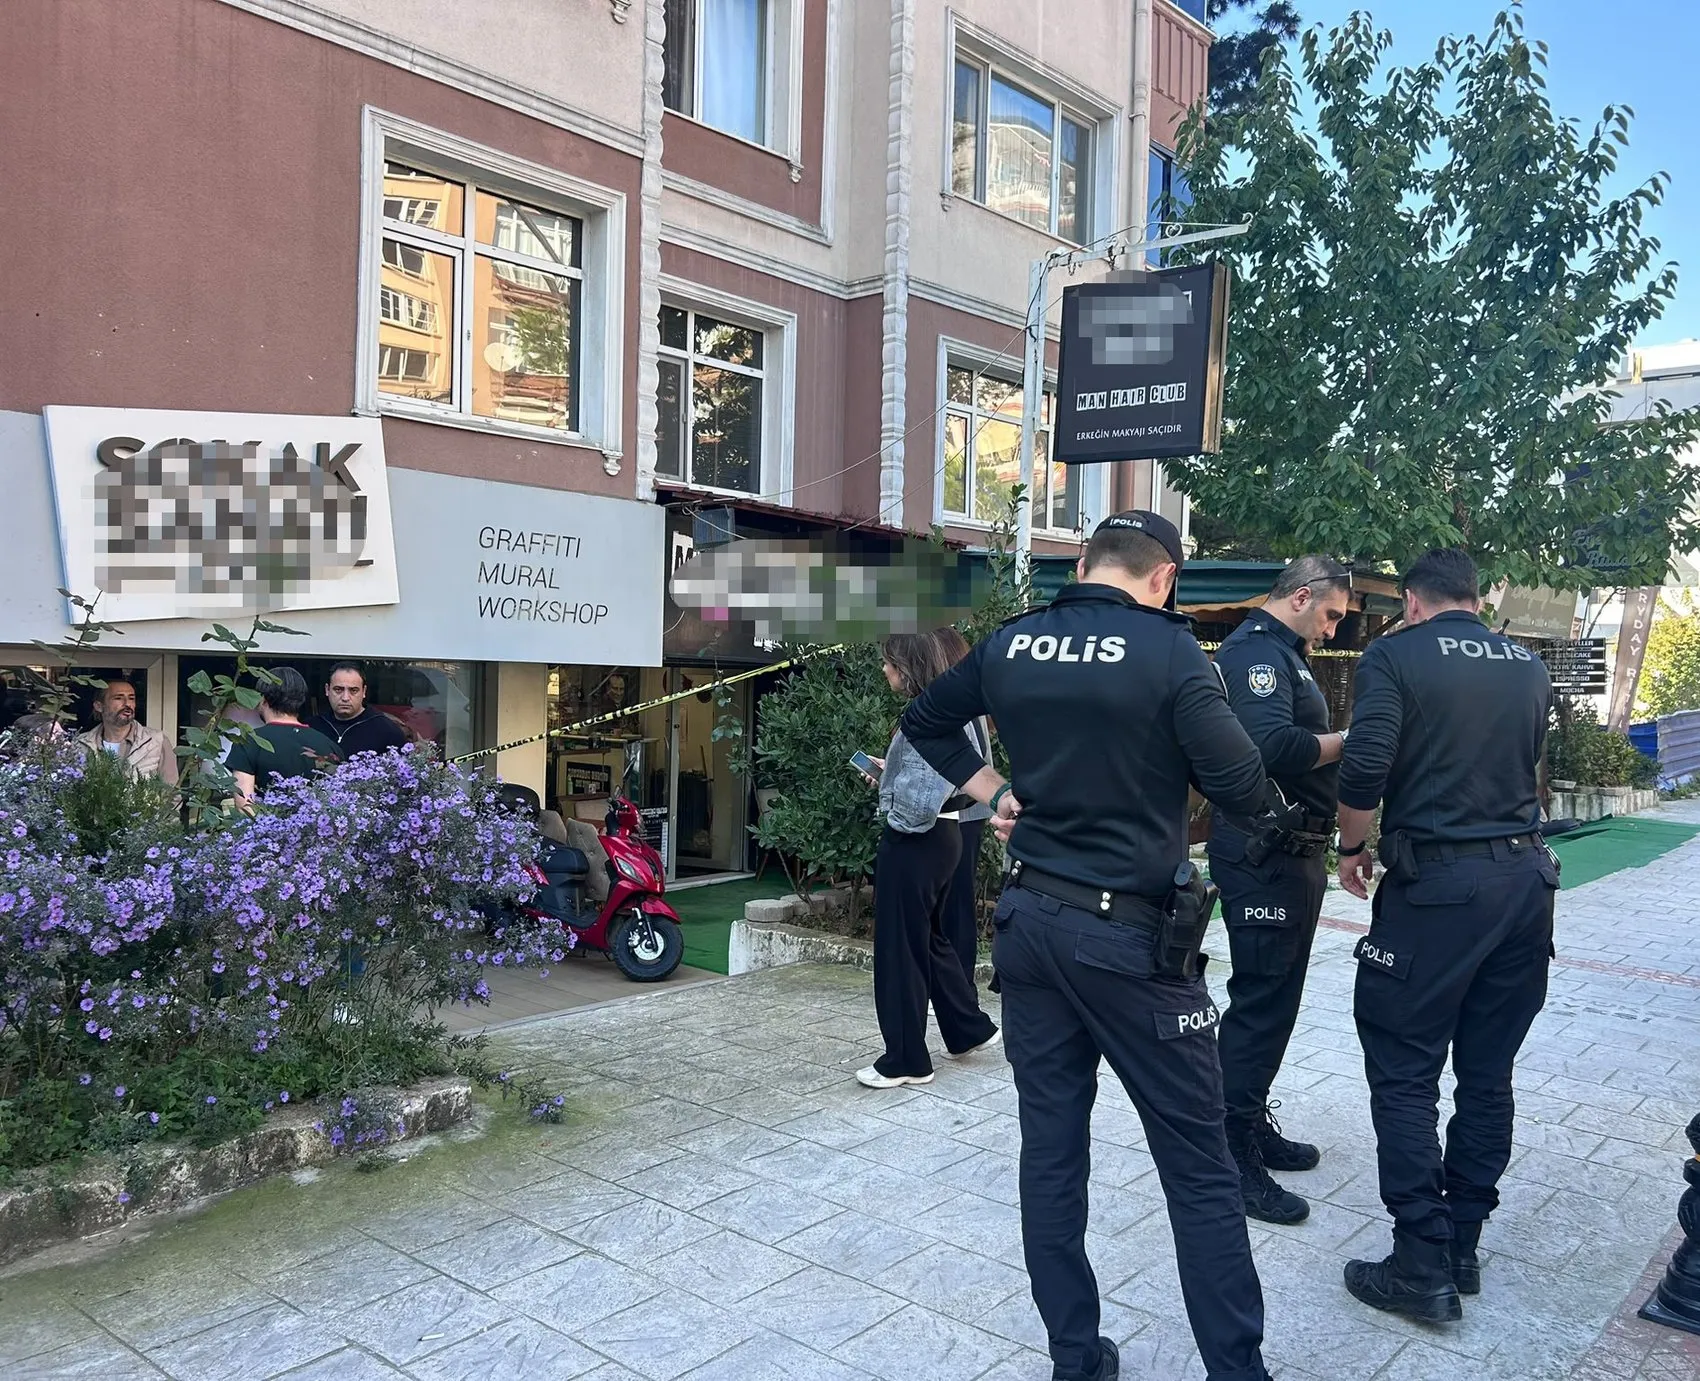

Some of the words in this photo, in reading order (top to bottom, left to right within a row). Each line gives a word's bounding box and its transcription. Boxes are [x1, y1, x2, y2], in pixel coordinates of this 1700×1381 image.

[1077, 393, 1107, 411] MAN
[1110, 387, 1146, 408] HAIR
[1150, 382, 1187, 403] CLUB
[1076, 428, 1110, 440] ERKEĞİN
[1111, 426, 1146, 439] MAKYAJI
[1147, 424, 1182, 436] SAÇIDIR
[479, 526, 581, 558] GRAFFITI
[478, 561, 560, 589] MURAL
[478, 595, 609, 625] WORKSHOP
